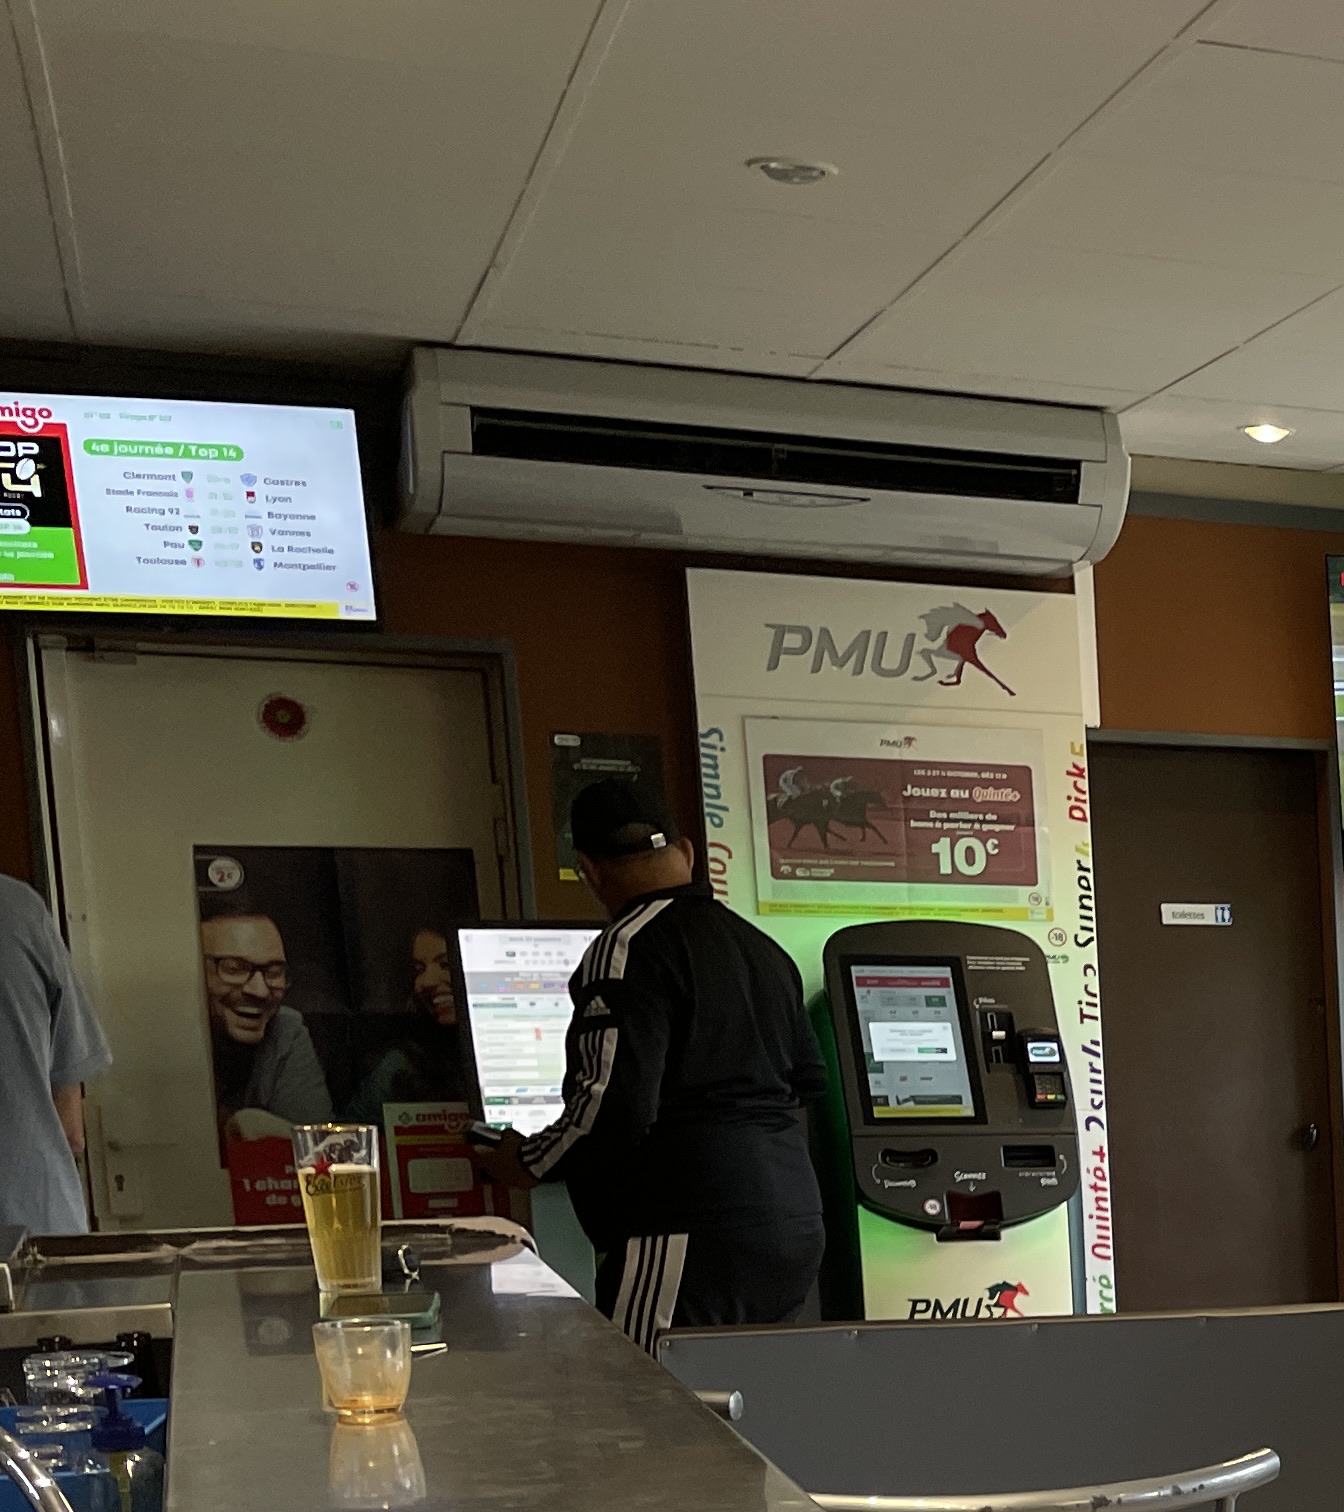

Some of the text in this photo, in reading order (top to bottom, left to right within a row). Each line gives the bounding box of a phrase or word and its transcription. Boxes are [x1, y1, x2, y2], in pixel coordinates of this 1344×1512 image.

[0, 402, 53, 429] migo
[189, 445, 220, 460] Top
[122, 470, 177, 482] Clermont
[263, 477, 308, 488] Castres
[265, 494, 293, 505] Lyon
[125, 505, 165, 517] Racing
[143, 523, 183, 533] Toulon
[763, 622, 917, 680] PMU
[902, 784, 947, 798] Jouez
[950, 788, 969, 798] au
[908, 1297, 984, 1320] PMU
